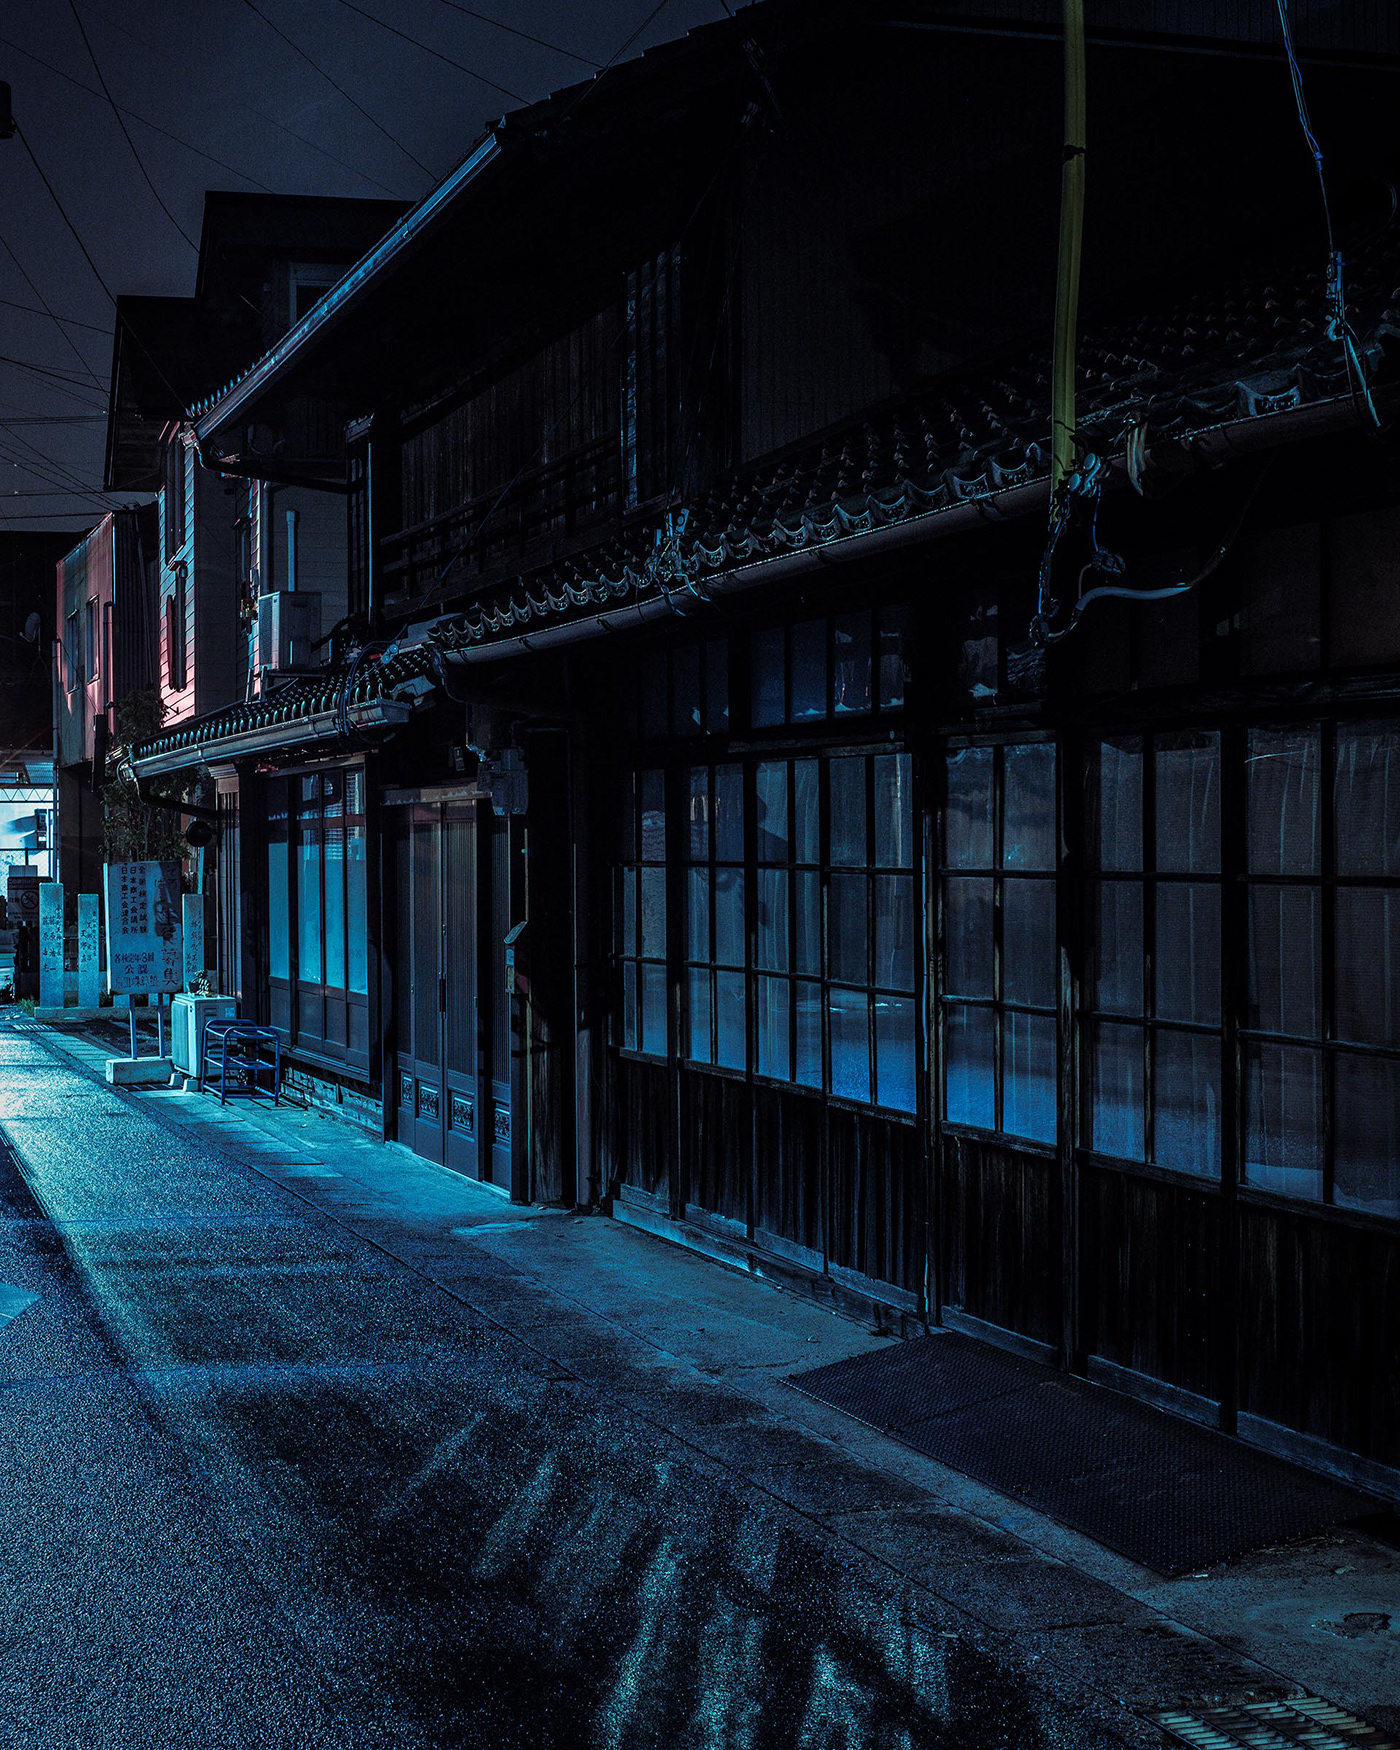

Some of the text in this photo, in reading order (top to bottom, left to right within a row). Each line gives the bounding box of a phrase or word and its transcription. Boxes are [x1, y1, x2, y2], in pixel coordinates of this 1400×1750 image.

[121, 866, 129, 935] 日本商工会連合会
[130, 866, 138, 934] 日本商工会議所
